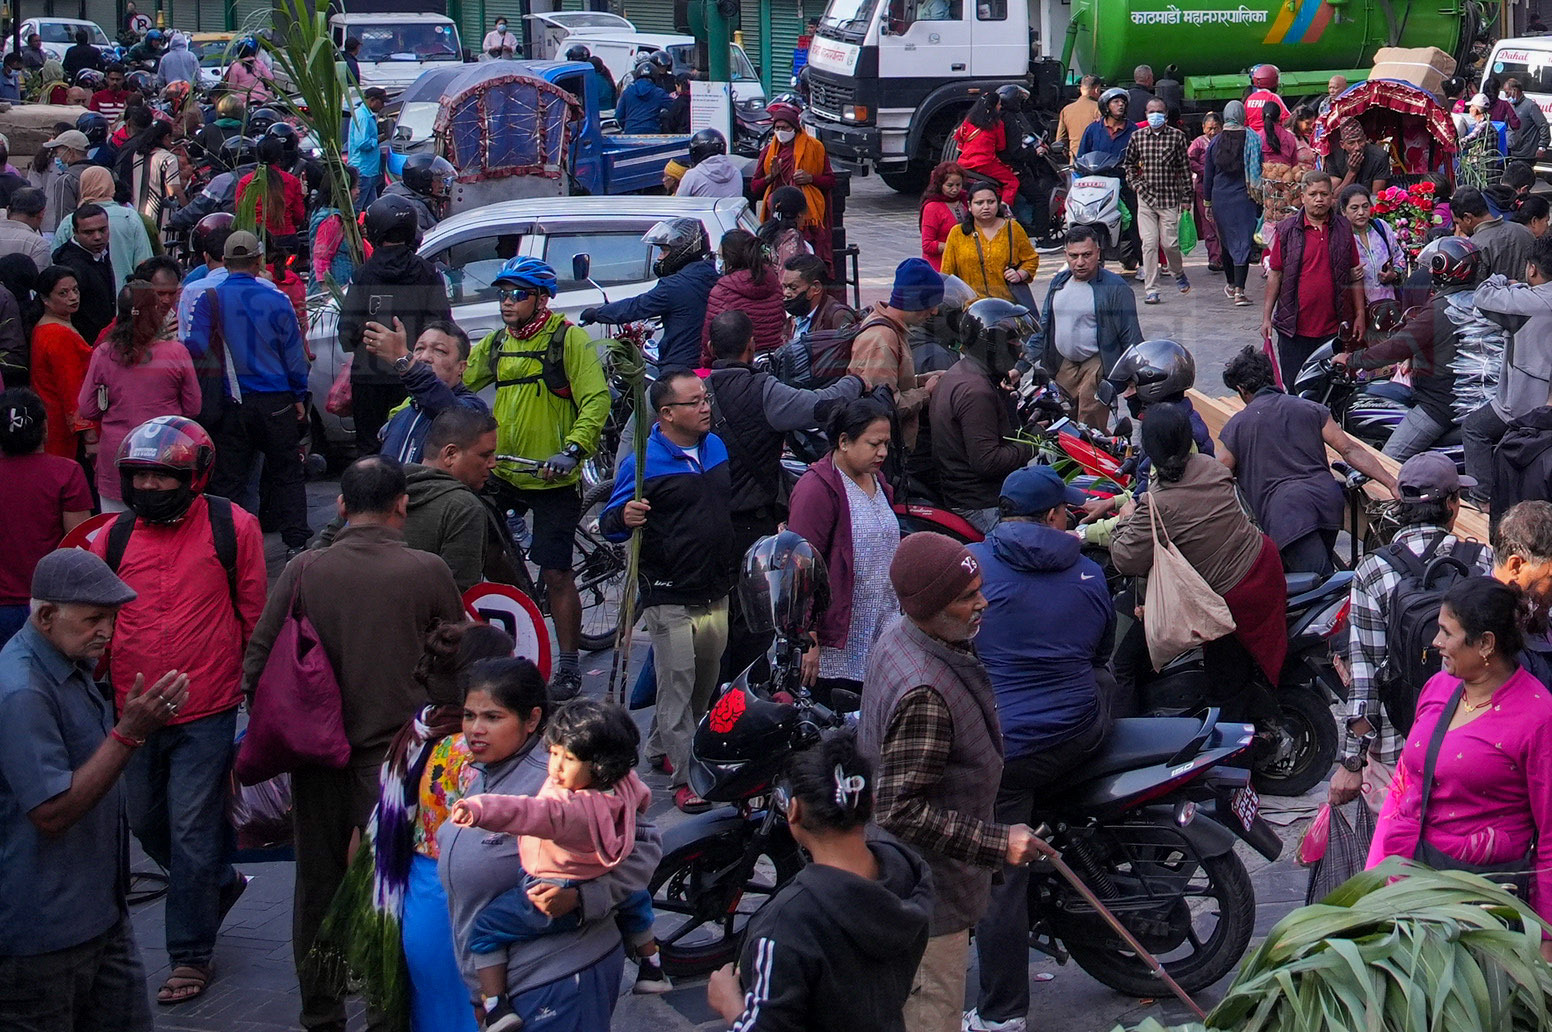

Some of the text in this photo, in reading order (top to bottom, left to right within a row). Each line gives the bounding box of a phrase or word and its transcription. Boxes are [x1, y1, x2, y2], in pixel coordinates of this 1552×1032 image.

[1183, 4, 1268, 28] महानगरपालिका
[1499, 51, 1528, 62] Dahal
[1171, 761, 1195, 777] 150
